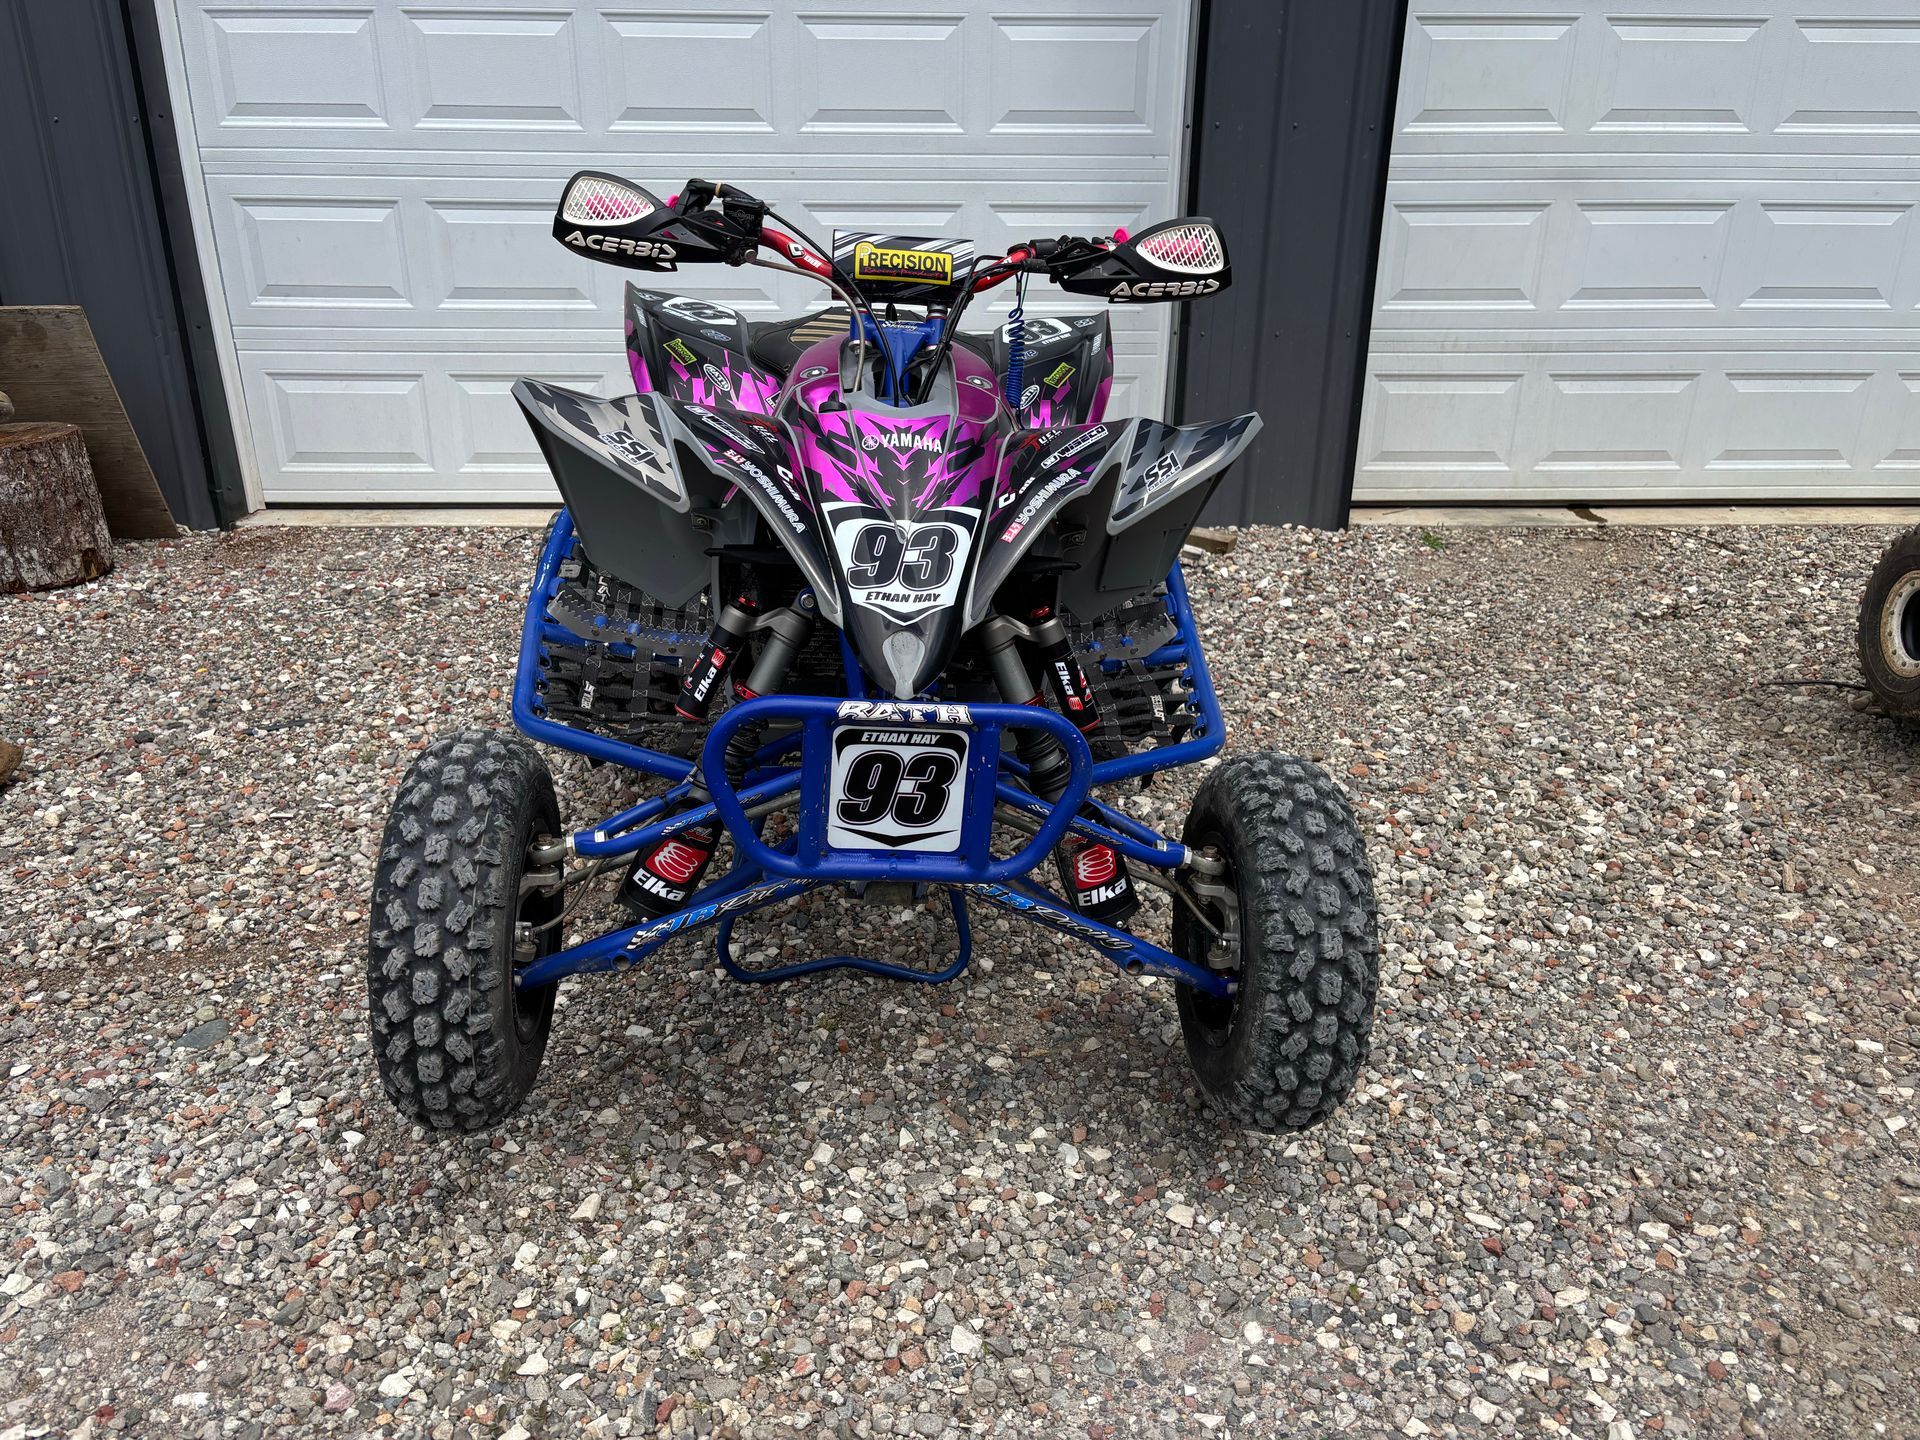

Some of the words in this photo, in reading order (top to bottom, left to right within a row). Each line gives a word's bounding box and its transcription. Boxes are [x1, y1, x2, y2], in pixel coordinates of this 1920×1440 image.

[564, 230, 677, 260] ACERBIS
[859, 245, 946, 274] PRECISION
[1109, 277, 1220, 297] ACERBIS
[600, 434, 640, 464] DECALS
[607, 430, 657, 462] SSI
[881, 433, 943, 454] YAMAHA
[1057, 425, 1108, 457] WISECO
[1143, 450, 1180, 484] SSI
[1147, 466, 1181, 492] DECALS
[741, 460, 806, 534] YOSHIMURA
[1015, 467, 1082, 526] YOSHIMURA
[847, 523, 958, 591] 93
[865, 591, 911, 603] ETHAN
[912, 592, 941, 603] HAY
[694, 666, 718, 702] Elka
[1054, 661, 1074, 696] Elka
[836, 700, 973, 725] RATH
[861, 732, 909, 744] ETHAN
[910, 733, 941, 745] HAY
[836, 750, 959, 828] 93
[632, 868, 687, 902] Elka
[1077, 876, 1128, 907] Elka
